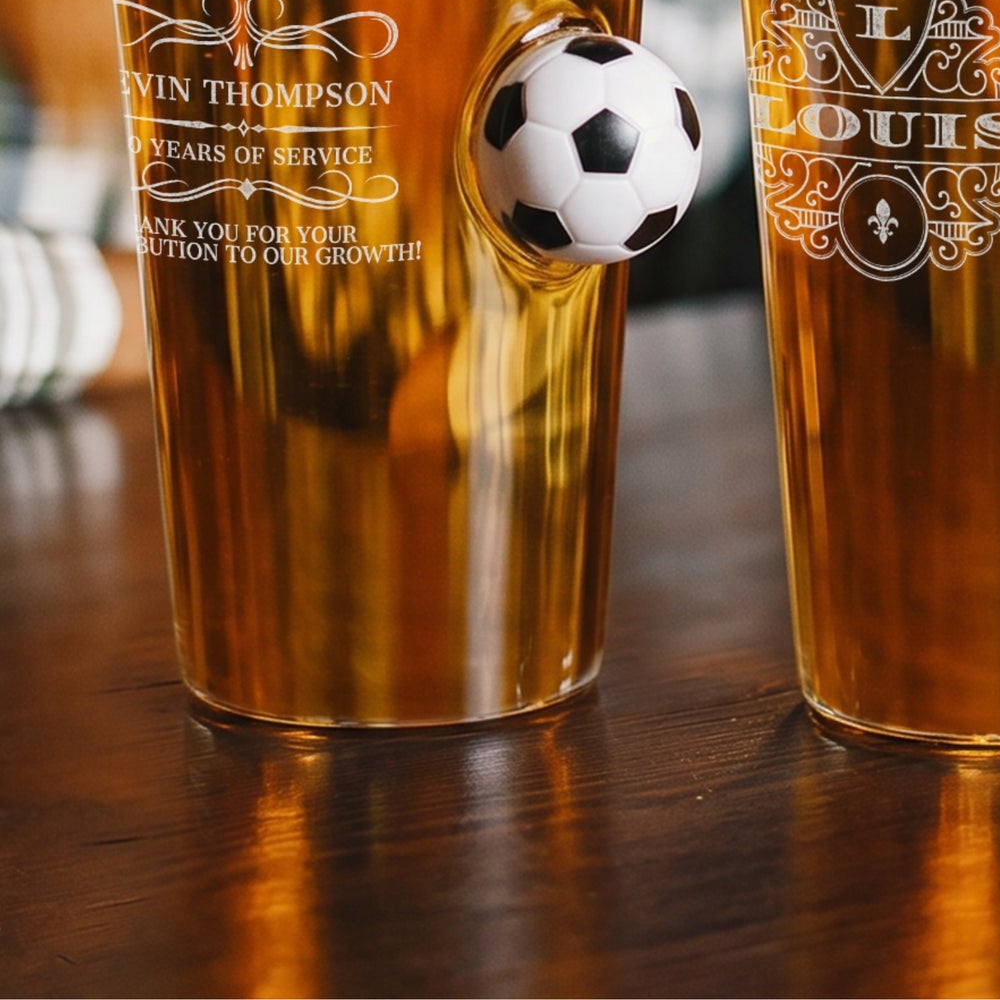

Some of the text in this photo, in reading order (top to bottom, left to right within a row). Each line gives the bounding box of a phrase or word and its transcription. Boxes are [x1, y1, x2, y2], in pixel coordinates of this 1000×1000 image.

[855, 3, 911, 41] L
[202, 79, 393, 108] THOMPSON
[149, 138, 226, 163] YEARS
[234, 146, 265, 165] OF
[273, 146, 373, 166] SERVICE
[135, 214, 357, 244] ANK YOU FOR YOUR
[225, 244, 256, 264] TO
[263, 246, 309, 265] OUR
[315, 240, 423, 265] GROWTH!
